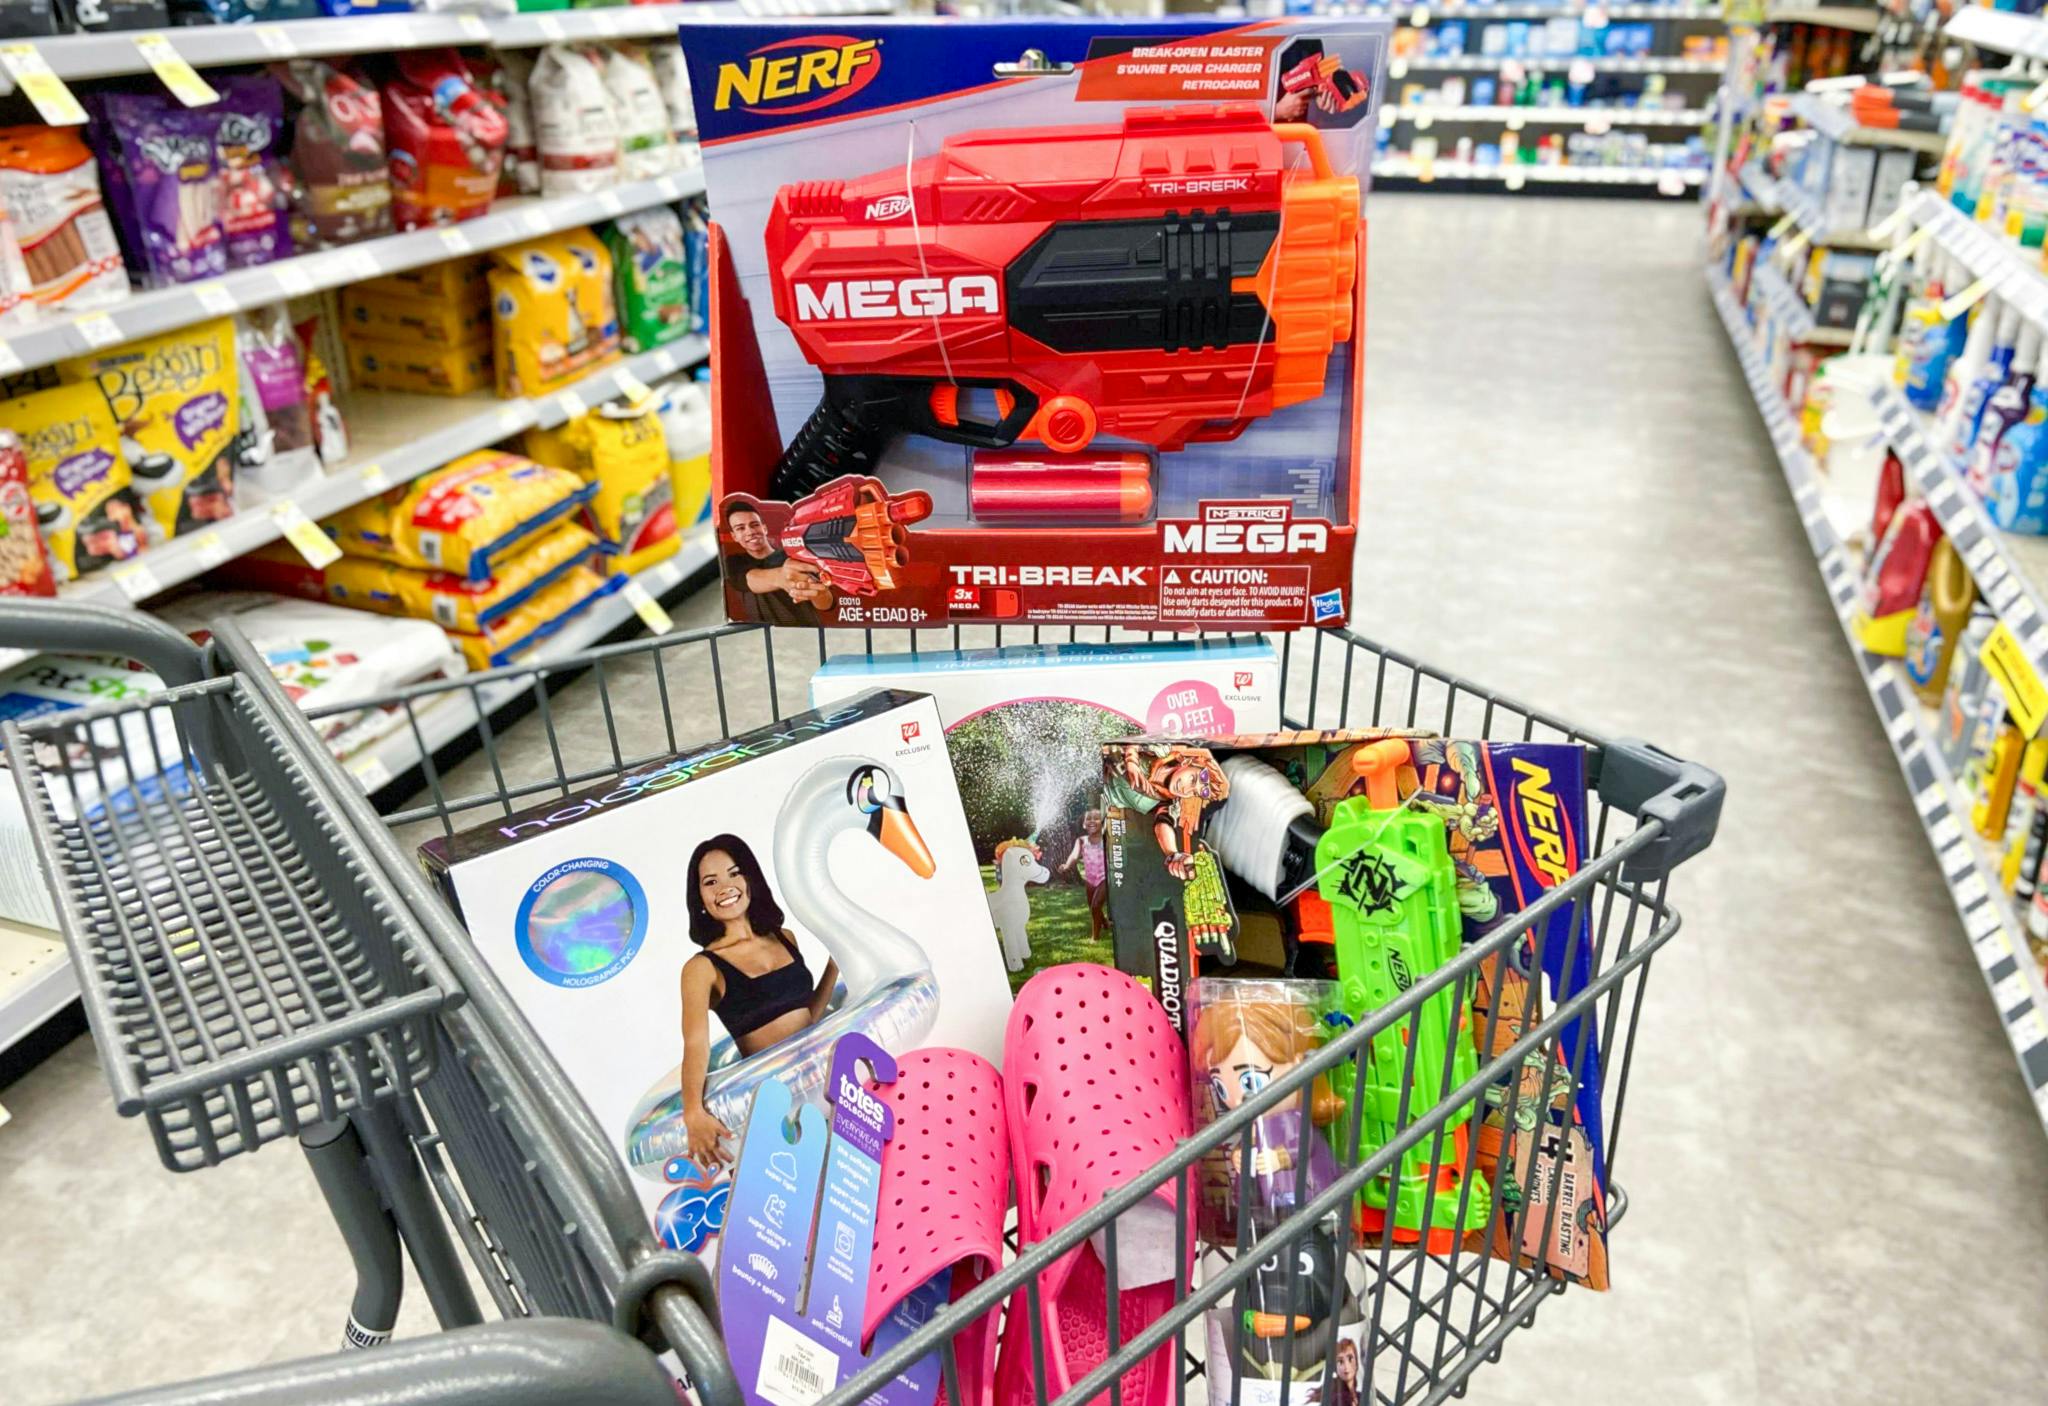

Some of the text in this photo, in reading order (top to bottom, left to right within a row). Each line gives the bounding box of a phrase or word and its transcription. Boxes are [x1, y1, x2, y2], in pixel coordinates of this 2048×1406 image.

[1132, 46, 1264, 58] BREAK-OPEN BLASTER
[714, 39, 877, 111] NERF
[1117, 63, 1262, 74] S'OUVRE POUR CHARGER
[1182, 79, 1260, 90] RETROCARGA
[1148, 178, 1249, 194] TRI-BREAK
[864, 196, 911, 221] NERF
[794, 275, 999, 321] MEGA
[1212, 508, 1282, 518] N-STRIKE
[1163, 523, 1328, 554] MEGA
[949, 565, 1148, 586] TRI-BREAK
[1190, 569, 1268, 585] CAUTION:
[954, 588, 973, 600] 3x
[1163, 587, 1306, 598] Do not aim at eyes or face. TO AVOID INJURY:
[1163, 597, 1303, 607] Use only darts designed for this product. Do
[838, 607, 928, 622] AGE EDAD 8+
[1163, 607, 1174, 617] not
[1175, 607, 1199, 618] modify
[1200, 607, 1216, 617] darts
[1217, 607, 1225, 617] or
[1226, 607, 1240, 617] dart
[1241, 607, 1265, 617] blaster.
[1166, 689, 1199, 710] OVER
[1224, 694, 1262, 702] EXCLUSIVE
[1184, 706, 1214, 729] FEET
[895, 743, 932, 757] EXCLUSIVE
[498, 706, 864, 839] holographic
[1511, 757, 1570, 888] NERF
[1111, 818, 1124, 888] AGE EDAD 8+
[533, 860, 609, 893] COLOR-CHANGING
[621, 947, 636, 968] PVC
[562, 962, 622, 986] HOLOGRAPHIC
[1153, 921, 1182, 1032] QUADROT
[840, 1073, 885, 1122] totes
[838, 1096, 882, 1133] SOLBOUNCE
[1559, 1172, 1575, 1256] BARREL BLASTING
[748, 1215, 766, 1232] super
[766, 1226, 787, 1248] strong
[756, 1230, 780, 1251] durable
[732, 1263, 756, 1286] bouncy
[761, 1283, 786, 1305] springy
[811, 1318, 853, 1349] anti-microbial
